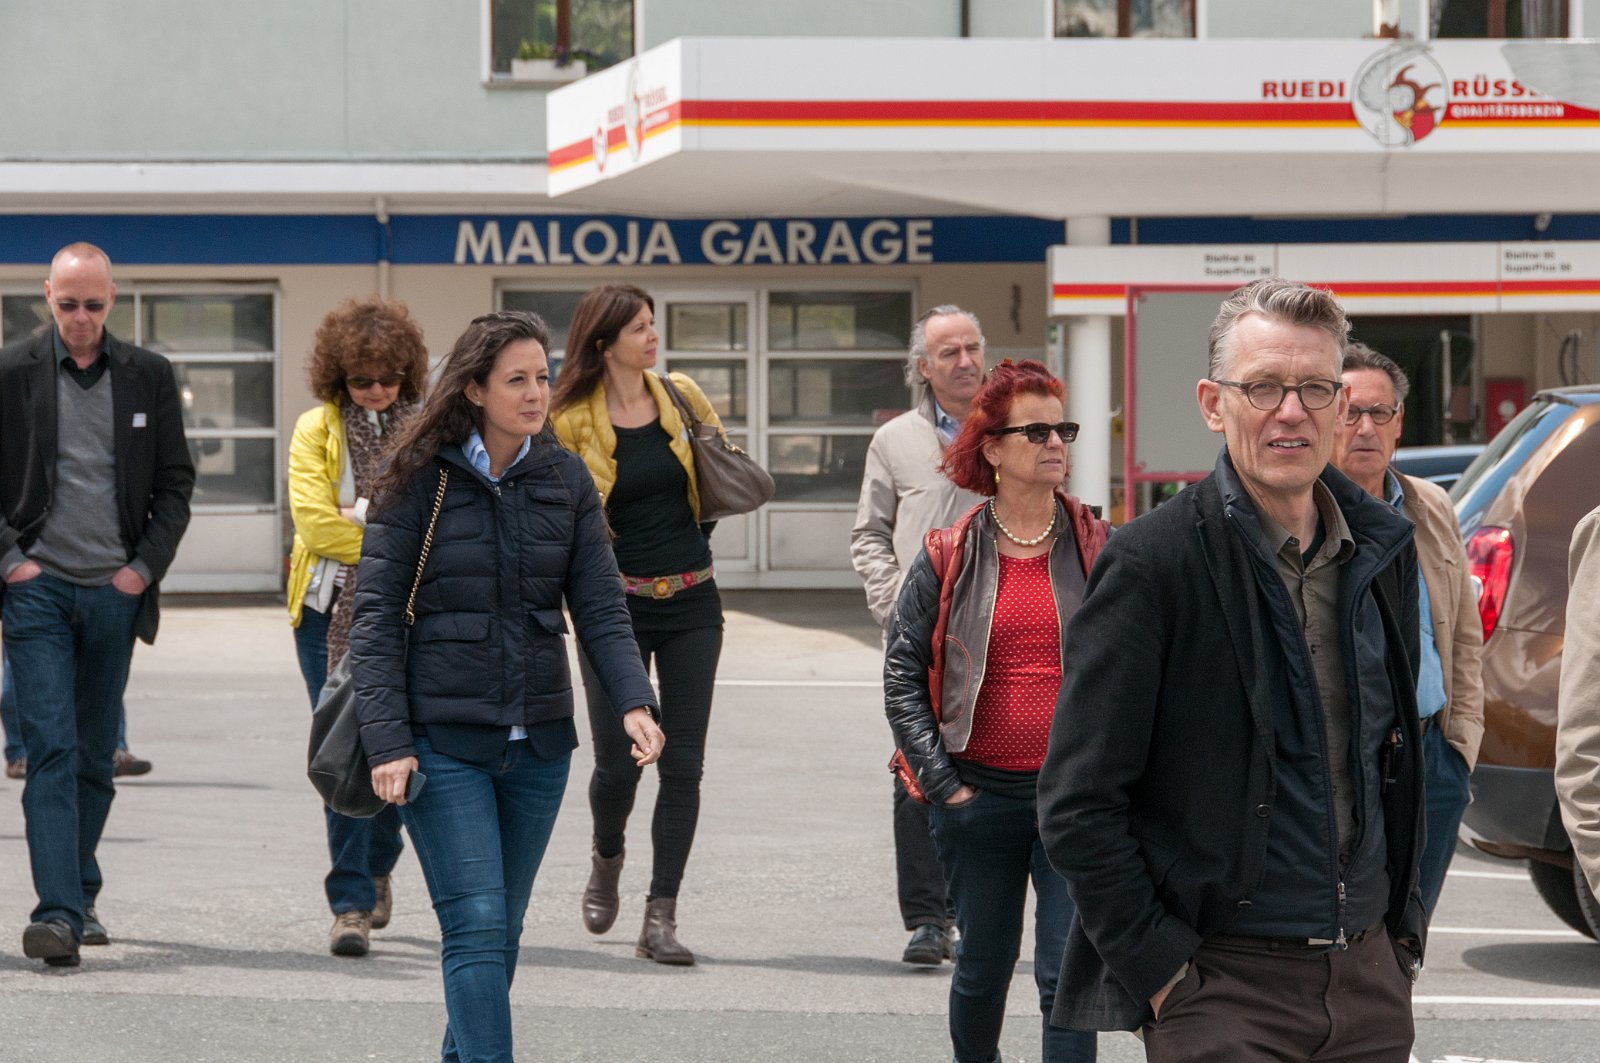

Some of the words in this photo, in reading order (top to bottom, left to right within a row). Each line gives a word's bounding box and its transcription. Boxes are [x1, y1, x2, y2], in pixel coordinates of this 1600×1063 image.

[1262, 80, 1345, 98] RUEDI
[1452, 74, 1536, 97] RÜSS
[454, 219, 682, 266] MALOJA
[701, 219, 934, 266] GARAGE
